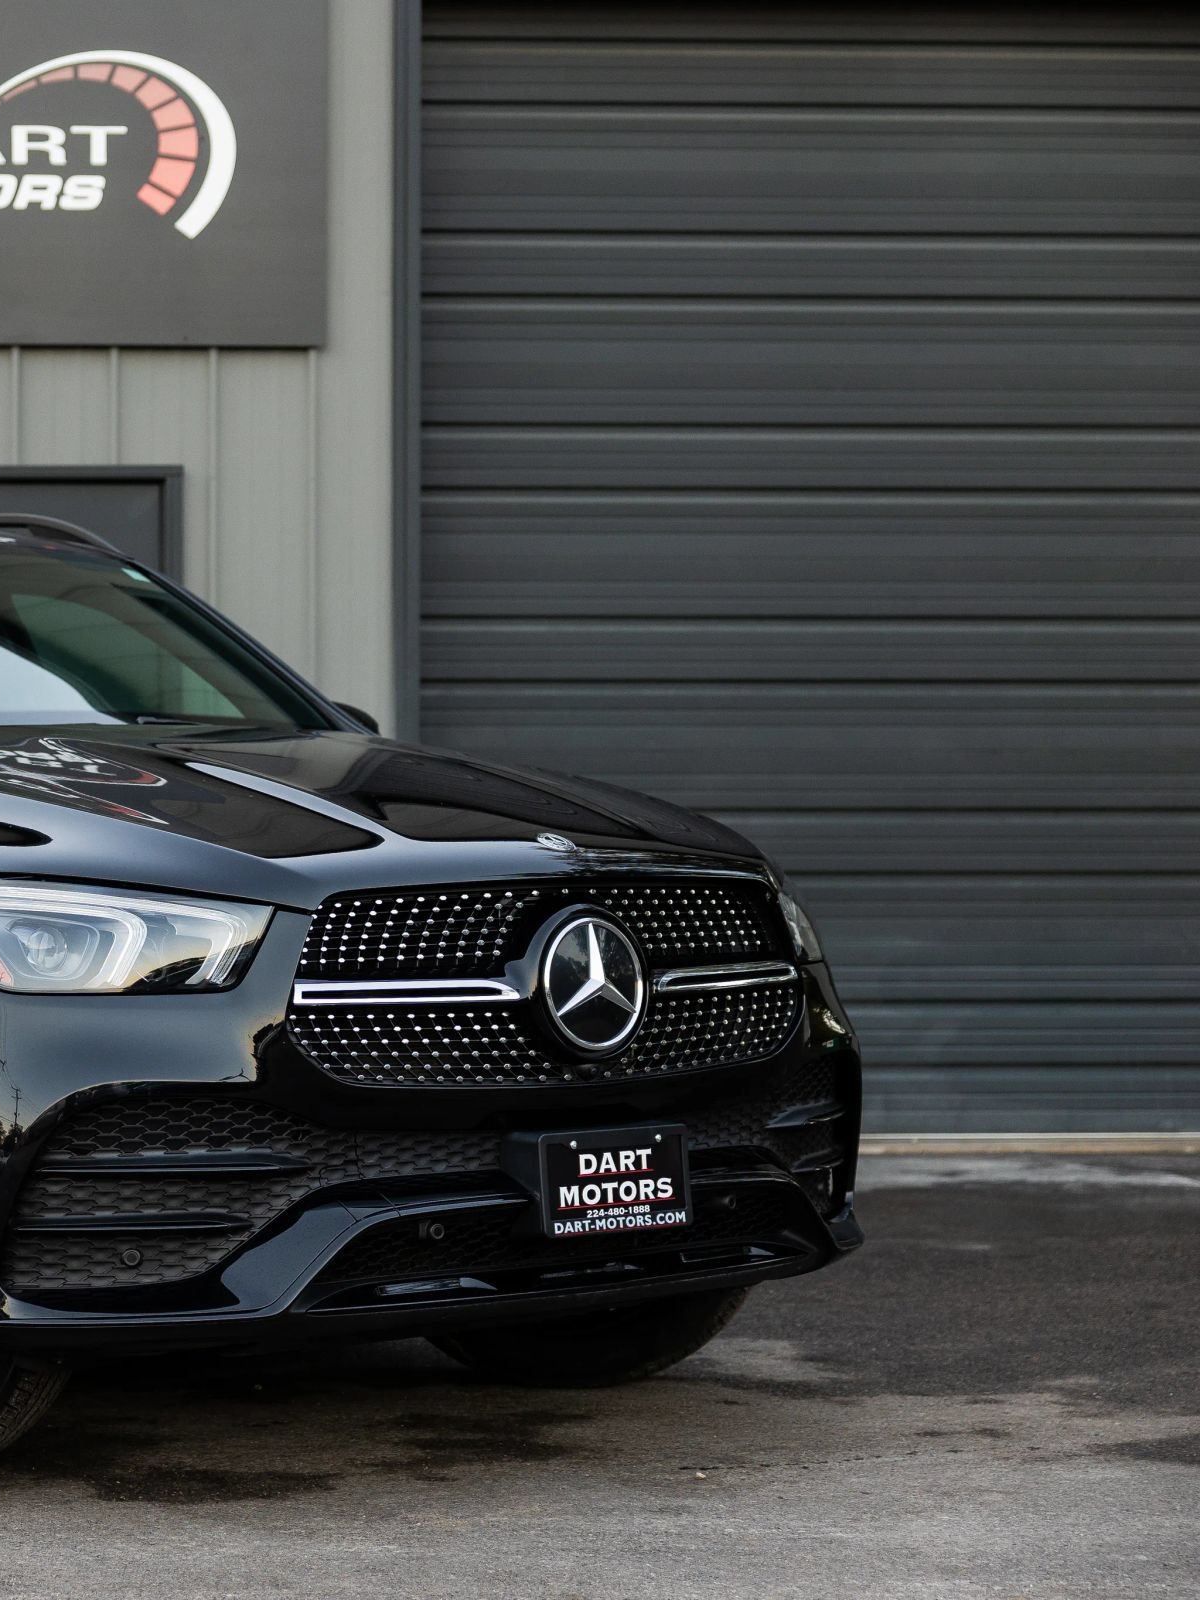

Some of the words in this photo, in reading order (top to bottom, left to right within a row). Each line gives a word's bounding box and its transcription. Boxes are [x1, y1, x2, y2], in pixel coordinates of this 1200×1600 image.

[578, 1148, 652, 1175] DART
[559, 1177, 673, 1207] MOTORS
[554, 1211, 687, 1235] DART-MOTORS.COM
[586, 1205, 651, 1218] 224-480-1888
